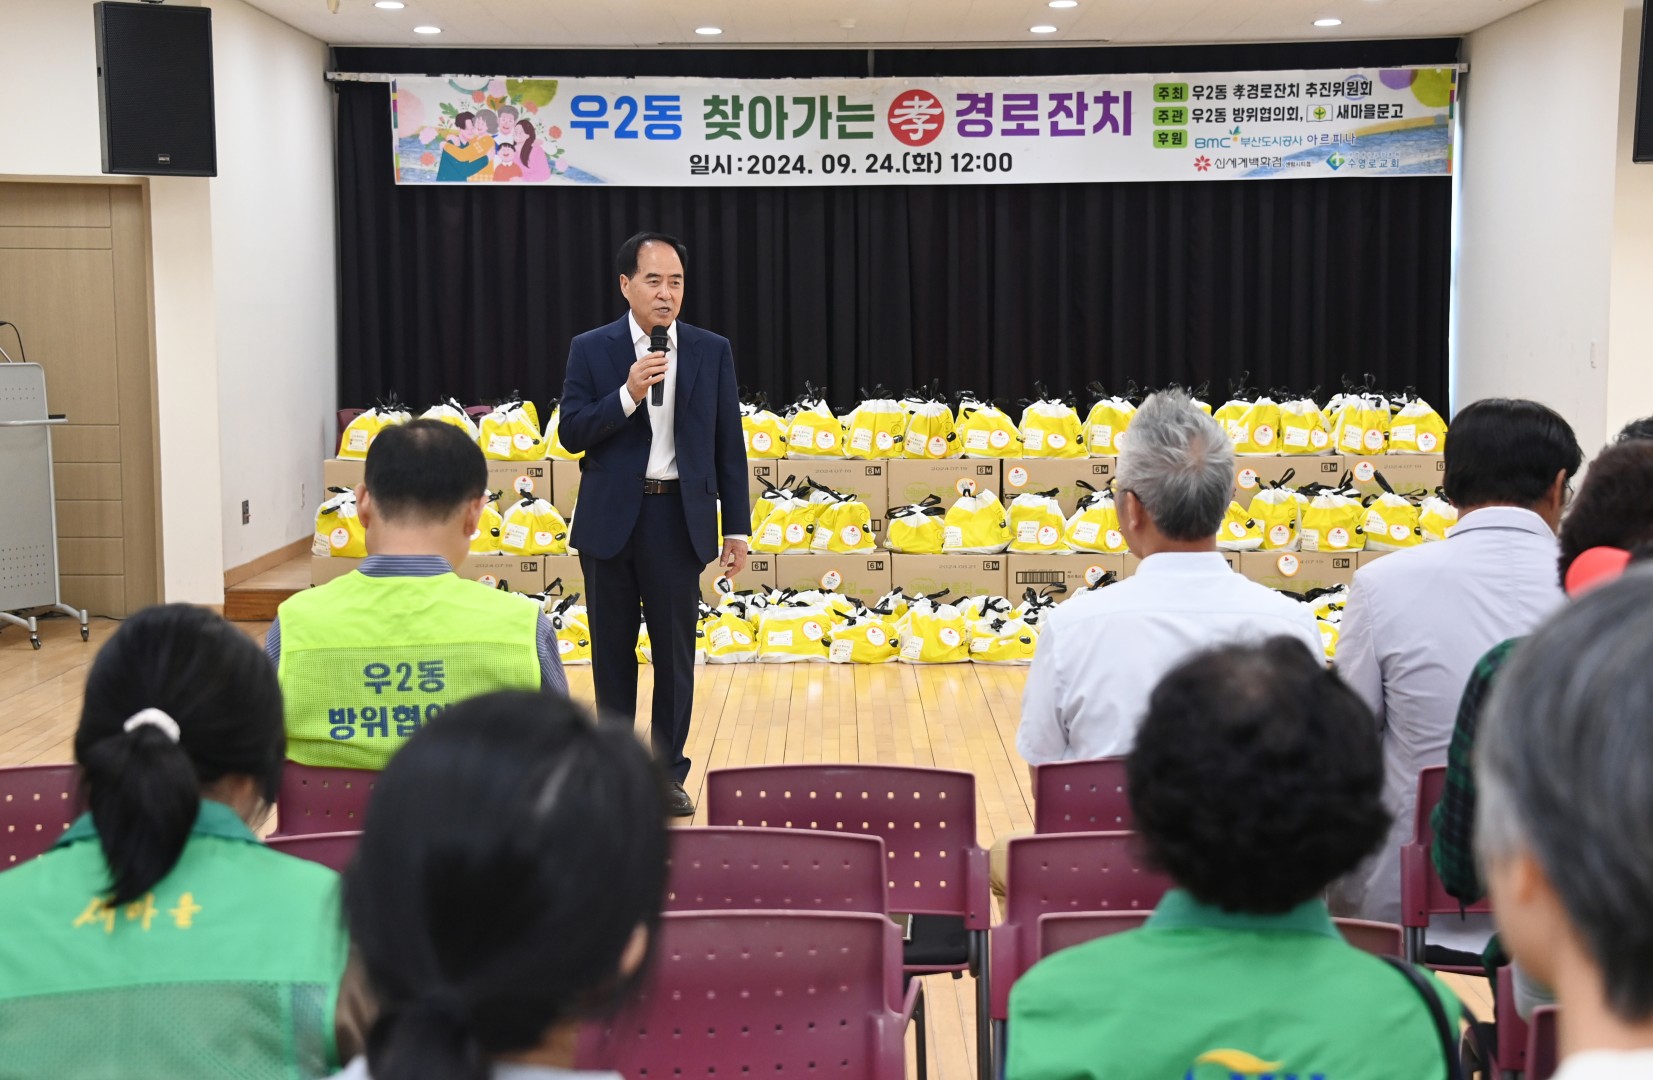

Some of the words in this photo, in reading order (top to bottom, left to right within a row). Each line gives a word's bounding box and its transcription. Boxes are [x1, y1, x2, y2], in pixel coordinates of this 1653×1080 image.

[1158, 85, 1183, 101] 주최
[1191, 84, 1228, 101] 우2동
[1232, 82, 1300, 100] 孝경로잔치
[1305, 80, 1373, 98] 추진위원회
[569, 94, 683, 141] 우2동
[703, 94, 876, 141] 찾아가는
[889, 93, 943, 142] 孝
[955, 90, 1133, 138] 경로잔치
[1158, 109, 1183, 124] 주관
[1191, 107, 1227, 124] 우2동
[1232, 105, 1303, 123] 방위협의회,
[1336, 103, 1404, 120] 새마을문고
[1157, 131, 1183, 145] 후원
[1194, 137, 1231, 149] BMC
[1240, 135, 1303, 148] 부산도시공사
[1306, 133, 1356, 146] 아르피나
[821, 153, 857, 175] 09.
[865, 151, 942, 175] 24.(화)
[950, 152, 1013, 174] 12:00
[1214, 156, 1283, 170] 신세계백화점
[1347, 158, 1400, 169] 수영로교회
[363, 660, 446, 695] 우2동
